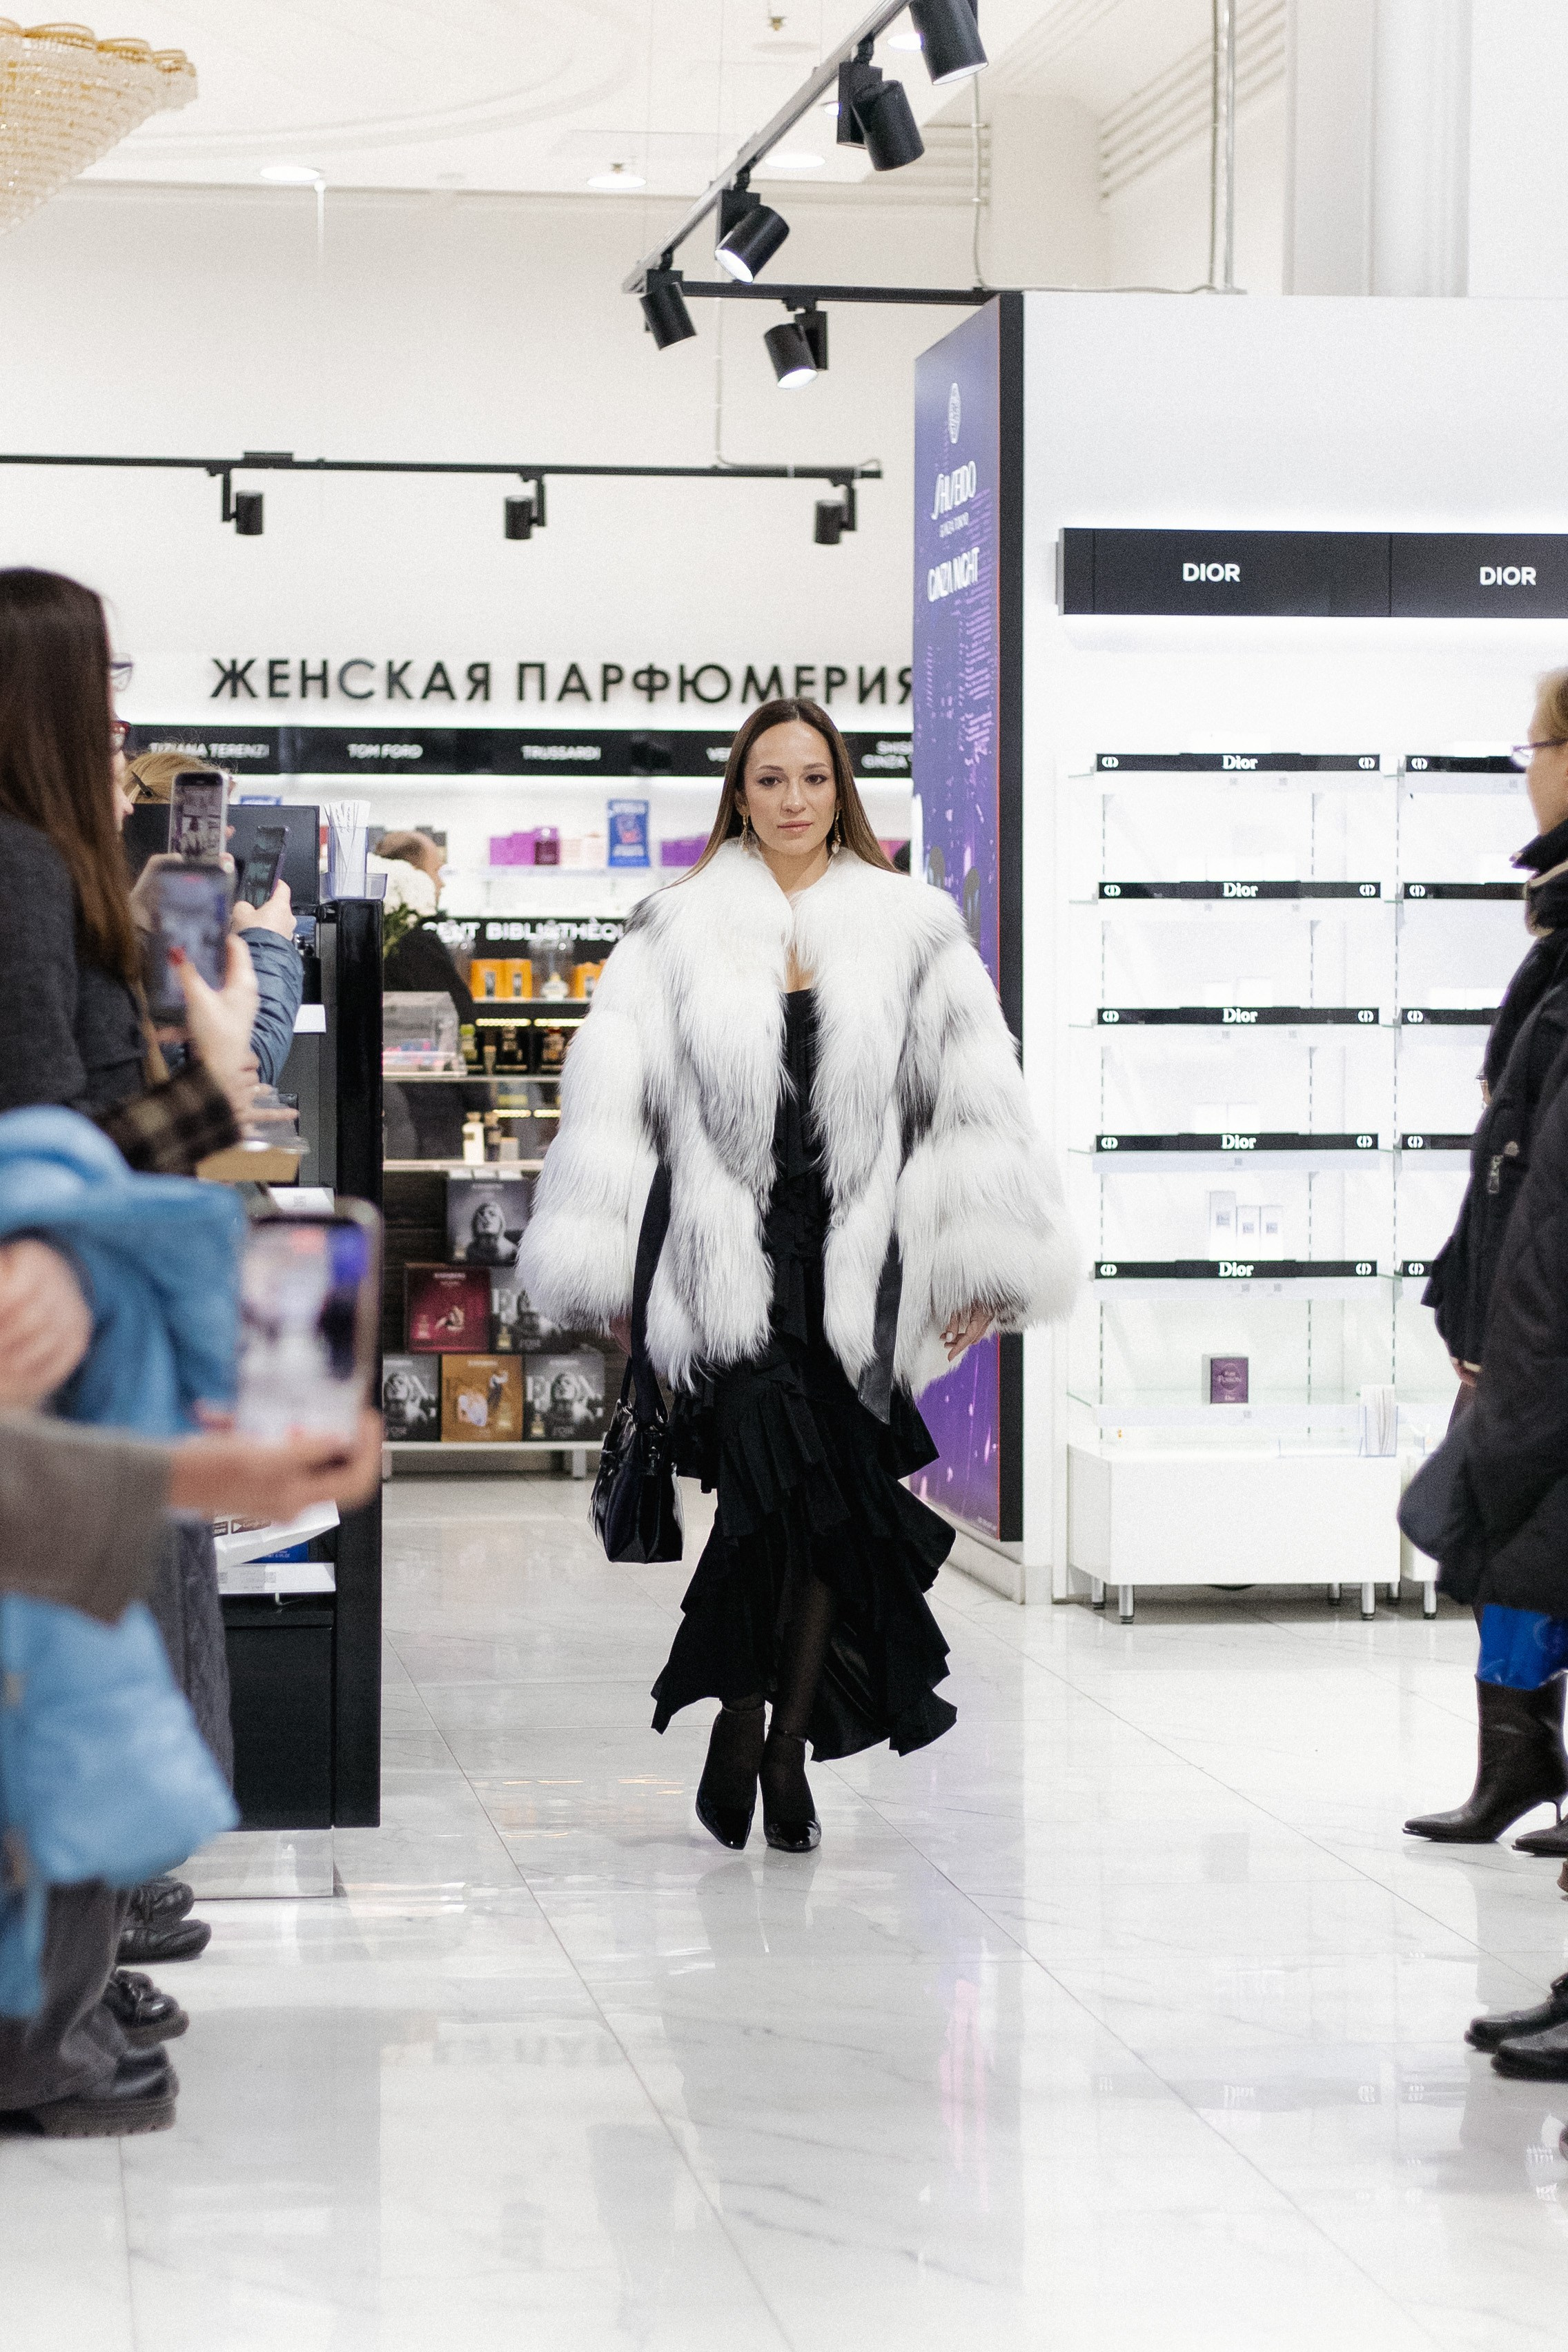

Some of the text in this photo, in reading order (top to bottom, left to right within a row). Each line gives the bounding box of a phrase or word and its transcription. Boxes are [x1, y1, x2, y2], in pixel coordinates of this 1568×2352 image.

[1182, 562, 1241, 582] DIOR
[1480, 566, 1537, 586] DIOR
[210, 658, 912, 705] ЖЕНСКАЯ ПАРФЮМЕРИЯ
[348, 743, 423, 759] TOM FORD
[521, 745, 601, 761] TRUSSARDI
[1222, 755, 1258, 770] Dior
[1223, 883, 1259, 898] Dior
[1222, 1008, 1258, 1023] Dior
[1221, 1134, 1257, 1150] Dior
[1218, 1262, 1255, 1277] Dior
